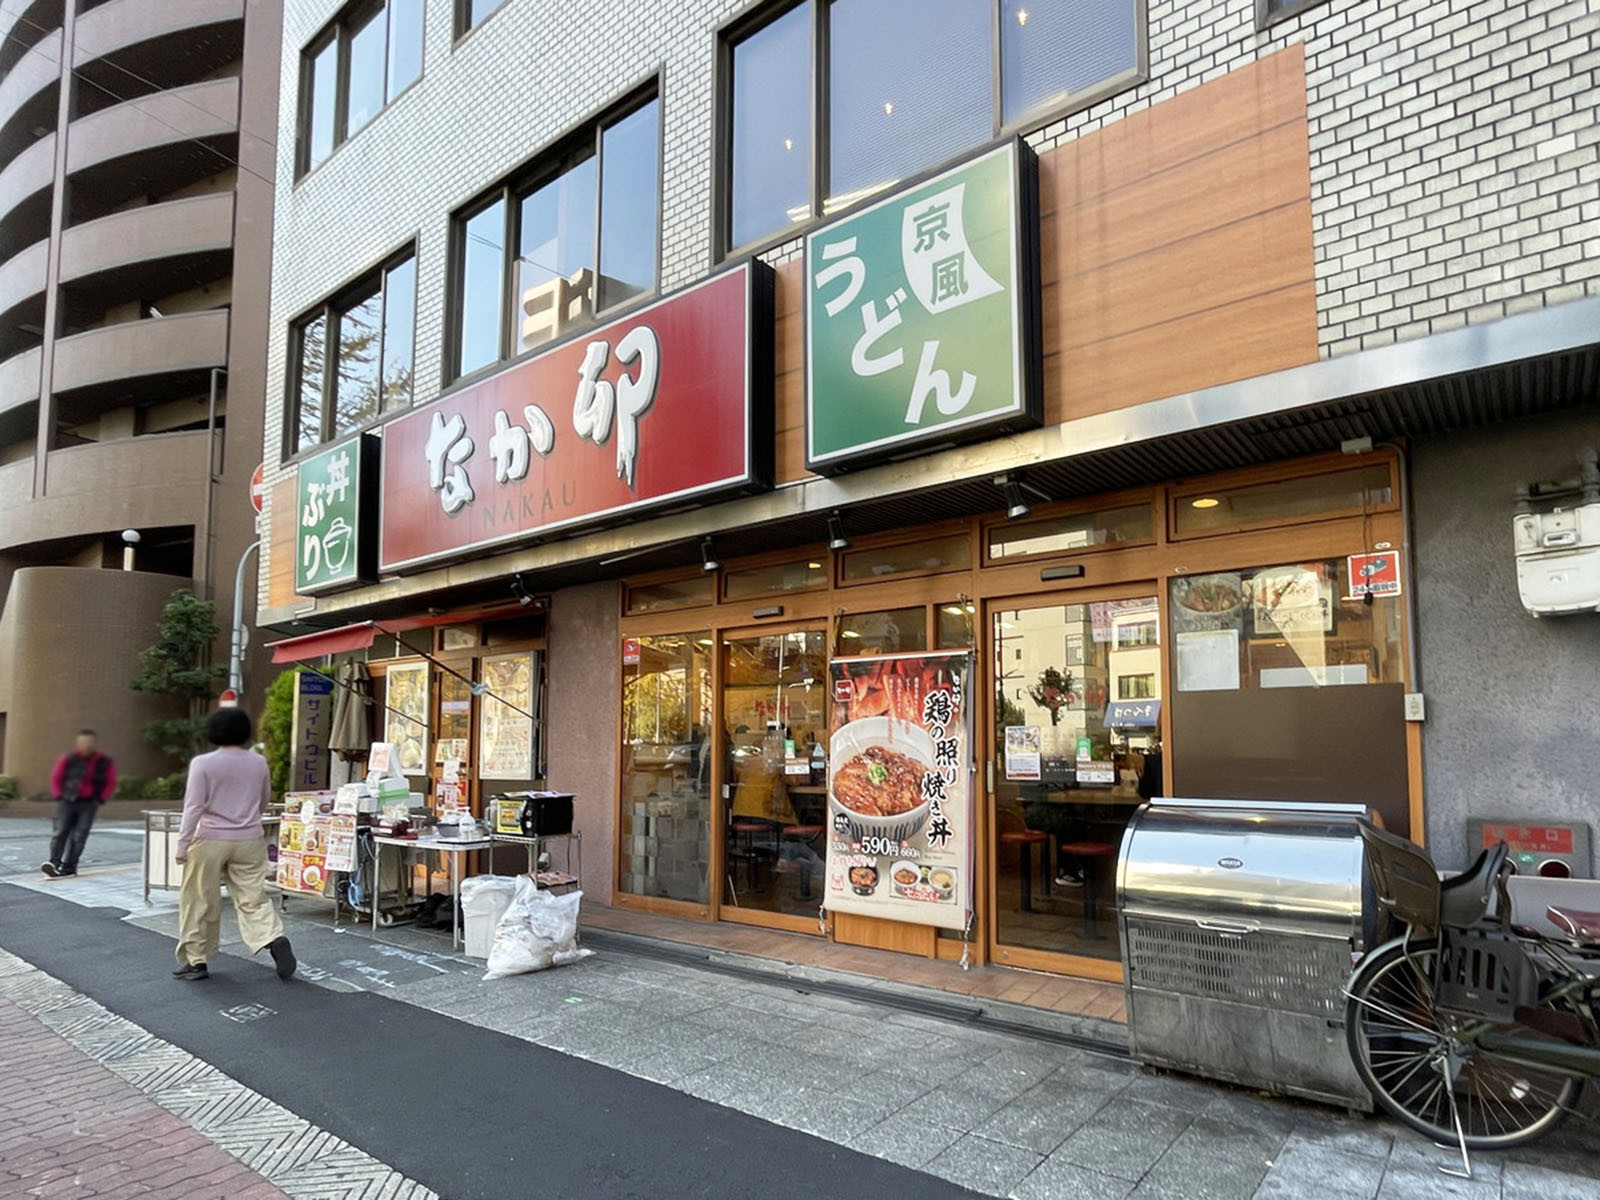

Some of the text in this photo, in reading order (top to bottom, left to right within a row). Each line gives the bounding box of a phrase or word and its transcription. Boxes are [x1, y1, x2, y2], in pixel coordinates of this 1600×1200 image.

[912, 203, 968, 306] 京風
[814, 236, 977, 425] うどん
[425, 325, 660, 515] なか卯
[302, 450, 350, 582] 丼ぶり
[482, 480, 578, 529] NAKAU
[923, 690, 960, 848] 鶏の照り焼き丼
